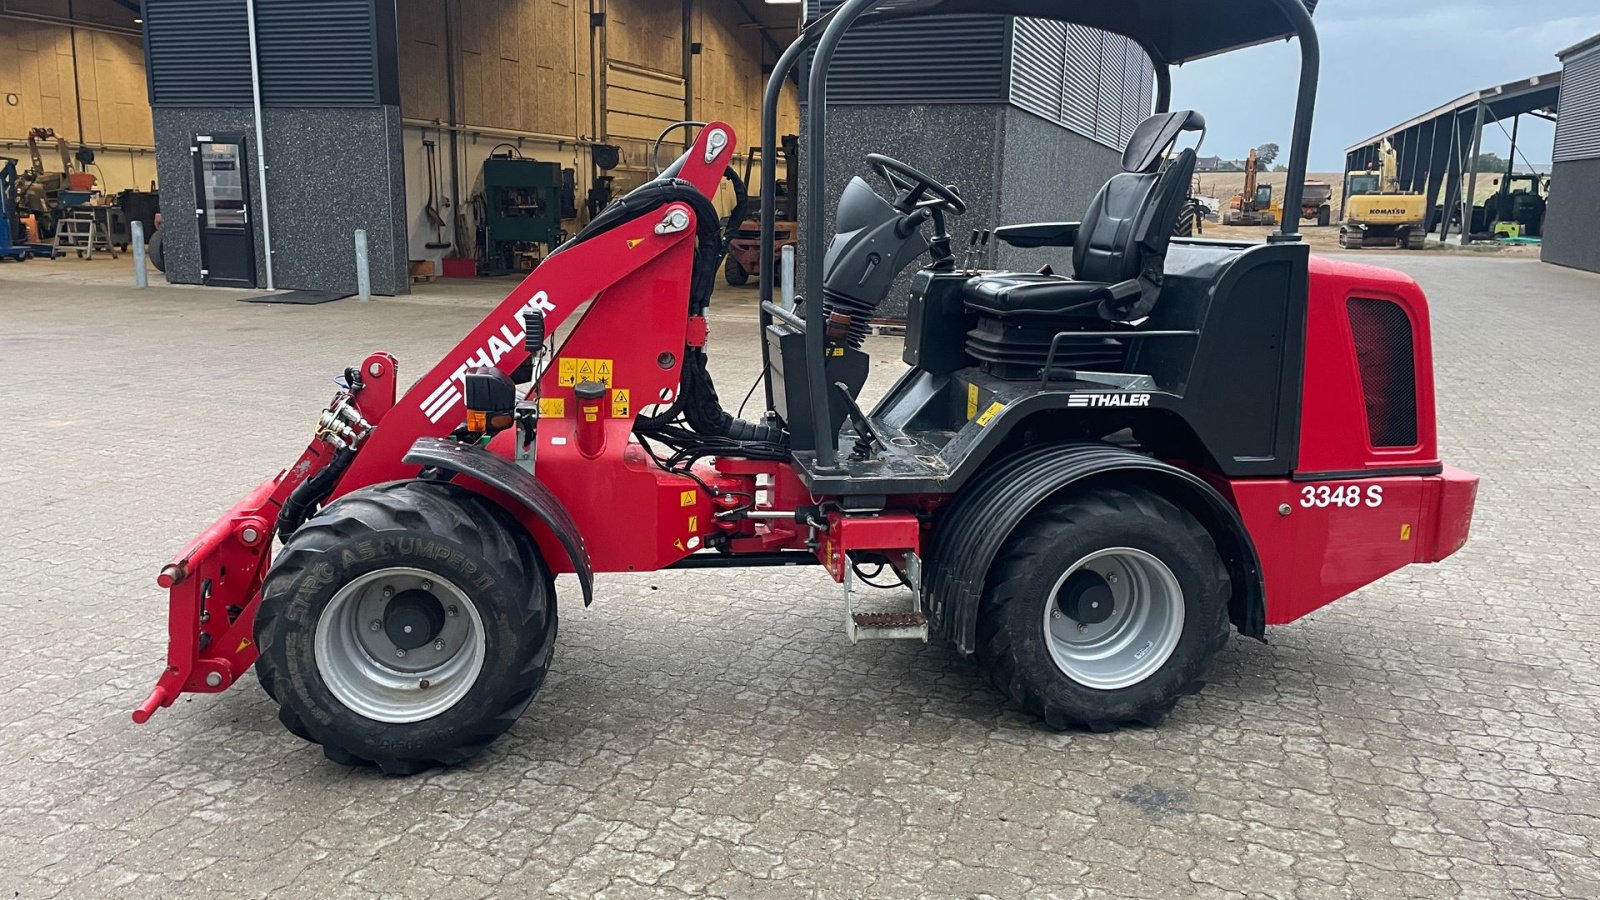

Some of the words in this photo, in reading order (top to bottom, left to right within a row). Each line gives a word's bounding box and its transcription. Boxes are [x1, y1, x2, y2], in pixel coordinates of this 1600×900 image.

[1089, 394, 1151, 407] THALER
[1300, 485, 1361, 508] 3348
[1365, 485, 1383, 508] S
